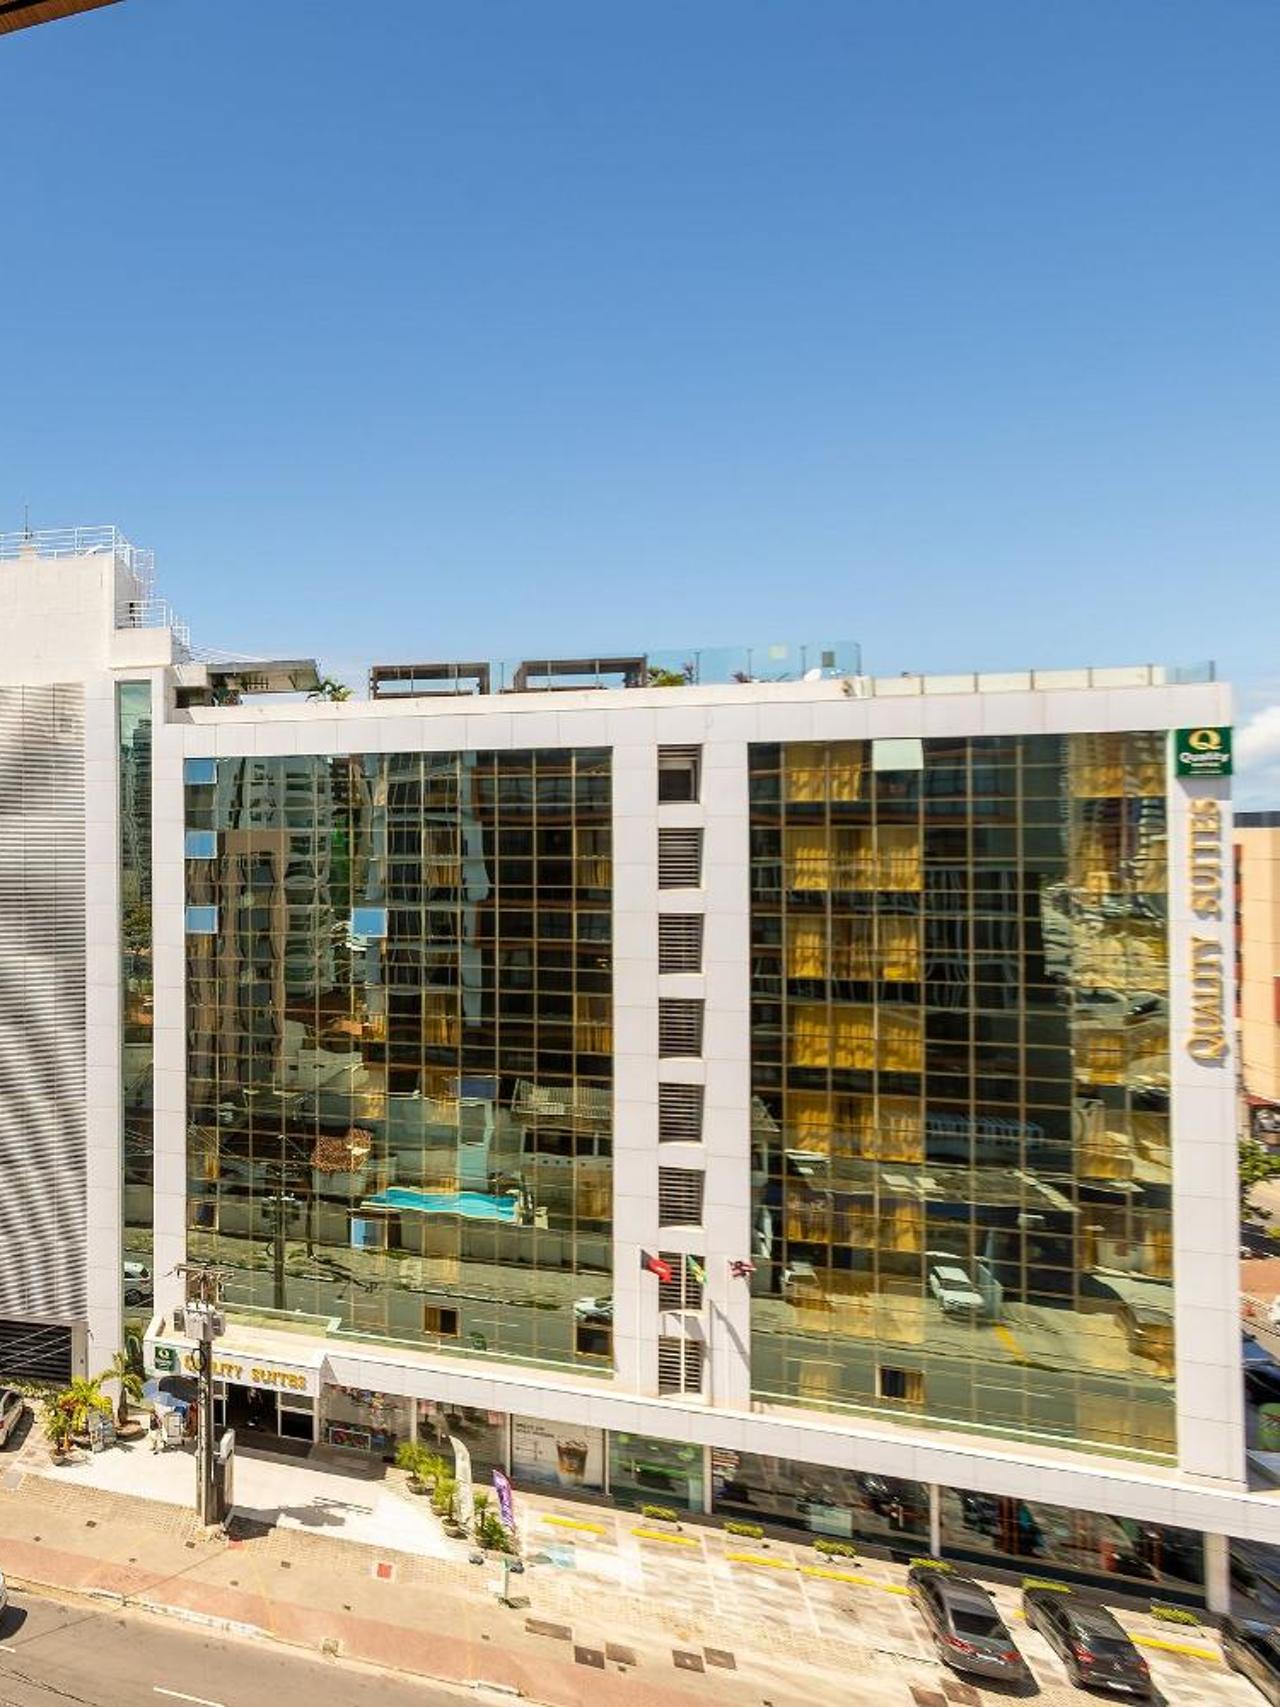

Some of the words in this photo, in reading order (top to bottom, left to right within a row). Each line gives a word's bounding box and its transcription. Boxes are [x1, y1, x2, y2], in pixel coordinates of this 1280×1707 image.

[1188, 729, 1223, 750] Q
[1189, 796, 1220, 912] SUITES
[1186, 935, 1227, 1059] QUALITY
